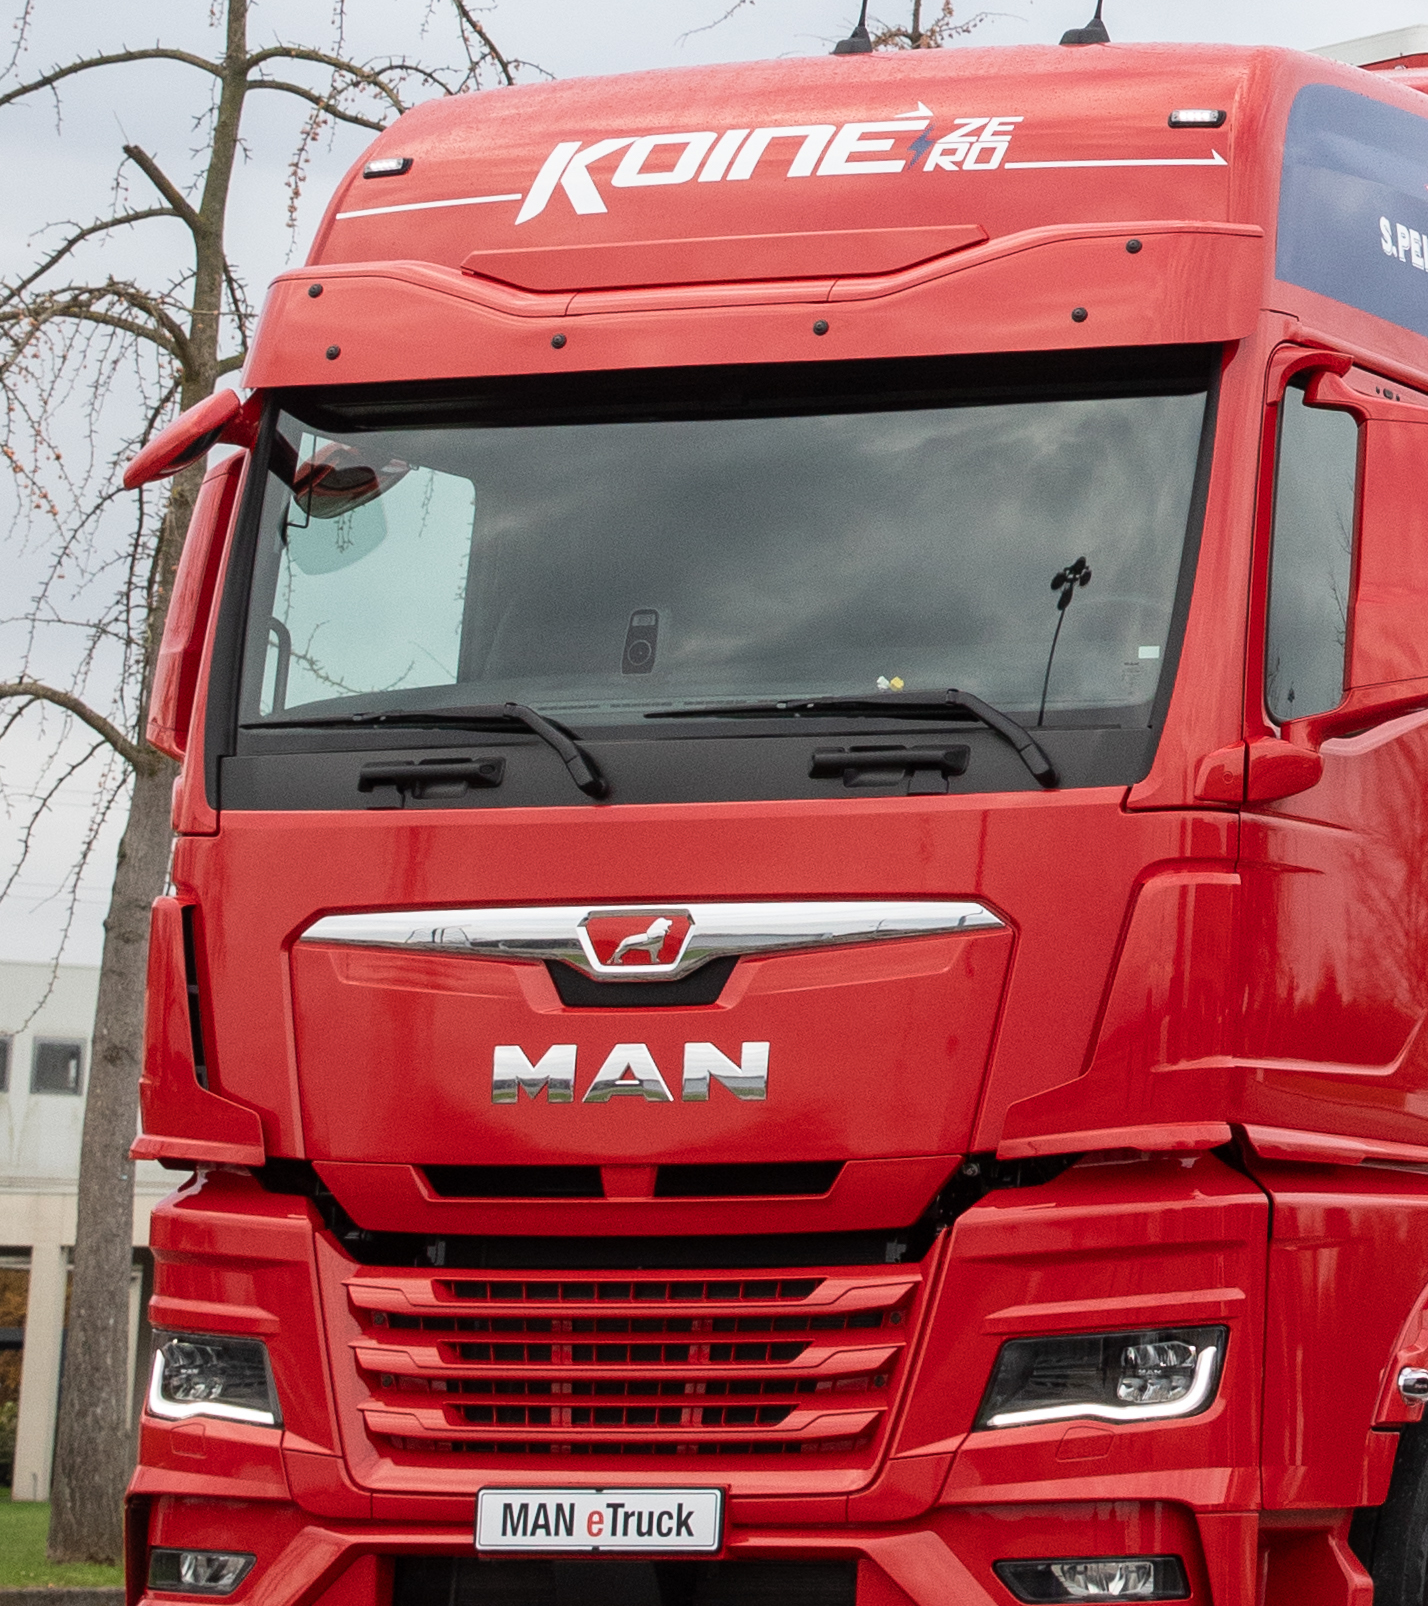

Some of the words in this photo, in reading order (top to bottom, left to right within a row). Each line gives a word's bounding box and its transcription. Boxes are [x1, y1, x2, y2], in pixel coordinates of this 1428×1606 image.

[938, 115, 1025, 143] ZE
[923, 141, 1010, 171] RO
[491, 1041, 770, 1104] MAN
[501, 1502, 576, 1537] MAN
[586, 1502, 695, 1538] eTruck
